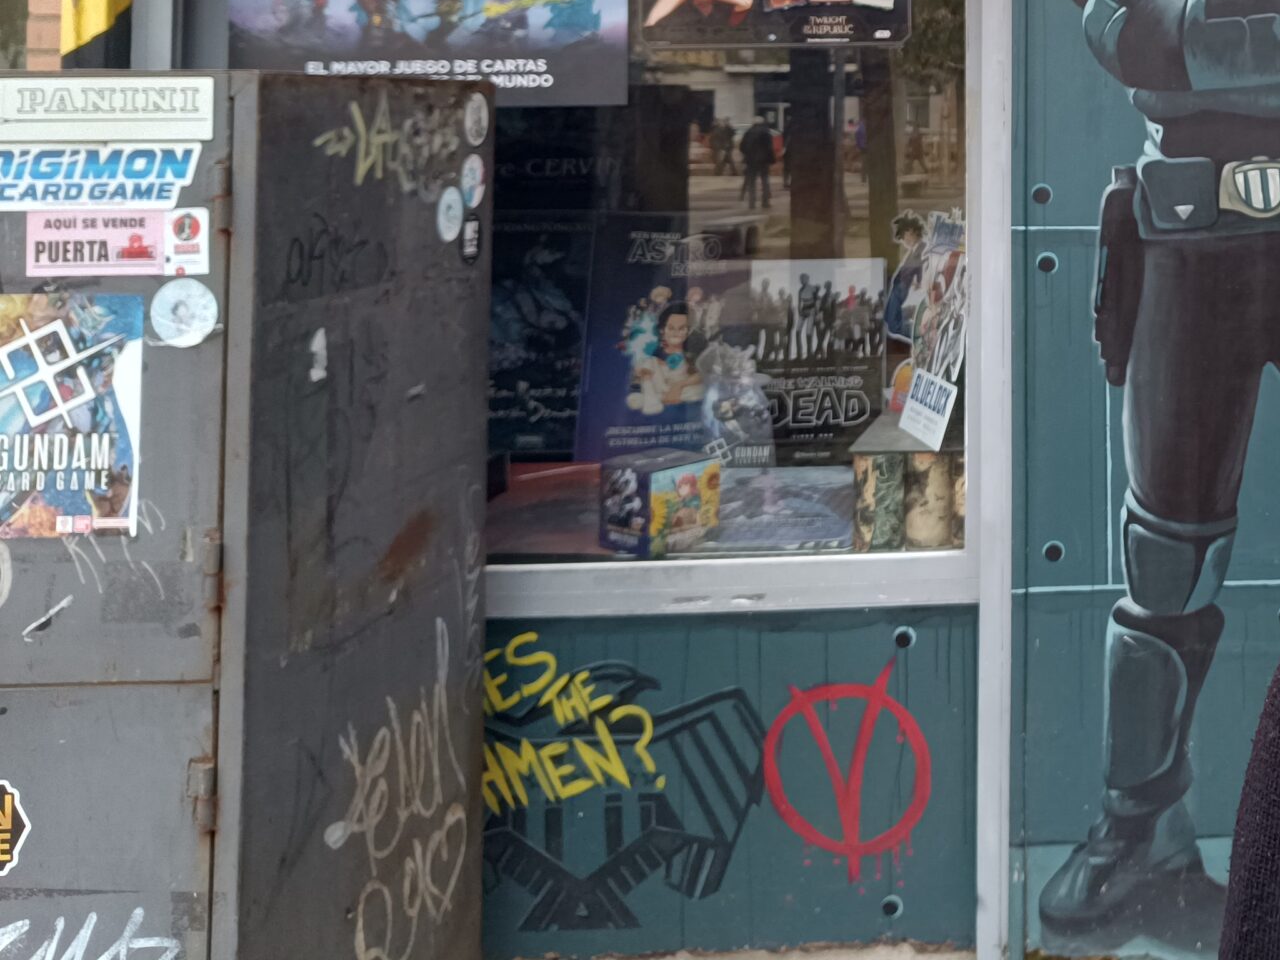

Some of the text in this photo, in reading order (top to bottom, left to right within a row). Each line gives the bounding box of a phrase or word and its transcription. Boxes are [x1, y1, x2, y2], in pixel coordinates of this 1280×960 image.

[304, 58, 548, 75] EL MAYOR JUEGO DE CARTAS
[16, 86, 201, 115] PANINI
[0, 182, 175, 201] CARD GAME
[81, 217, 98, 230] SE
[102, 216, 146, 230] VENDE
[34, 239, 110, 264] PUERTA
[764, 386, 871, 428] DEAD
[0, 470, 109, 492] ARD GAME
[537, 669, 615, 728] THE
